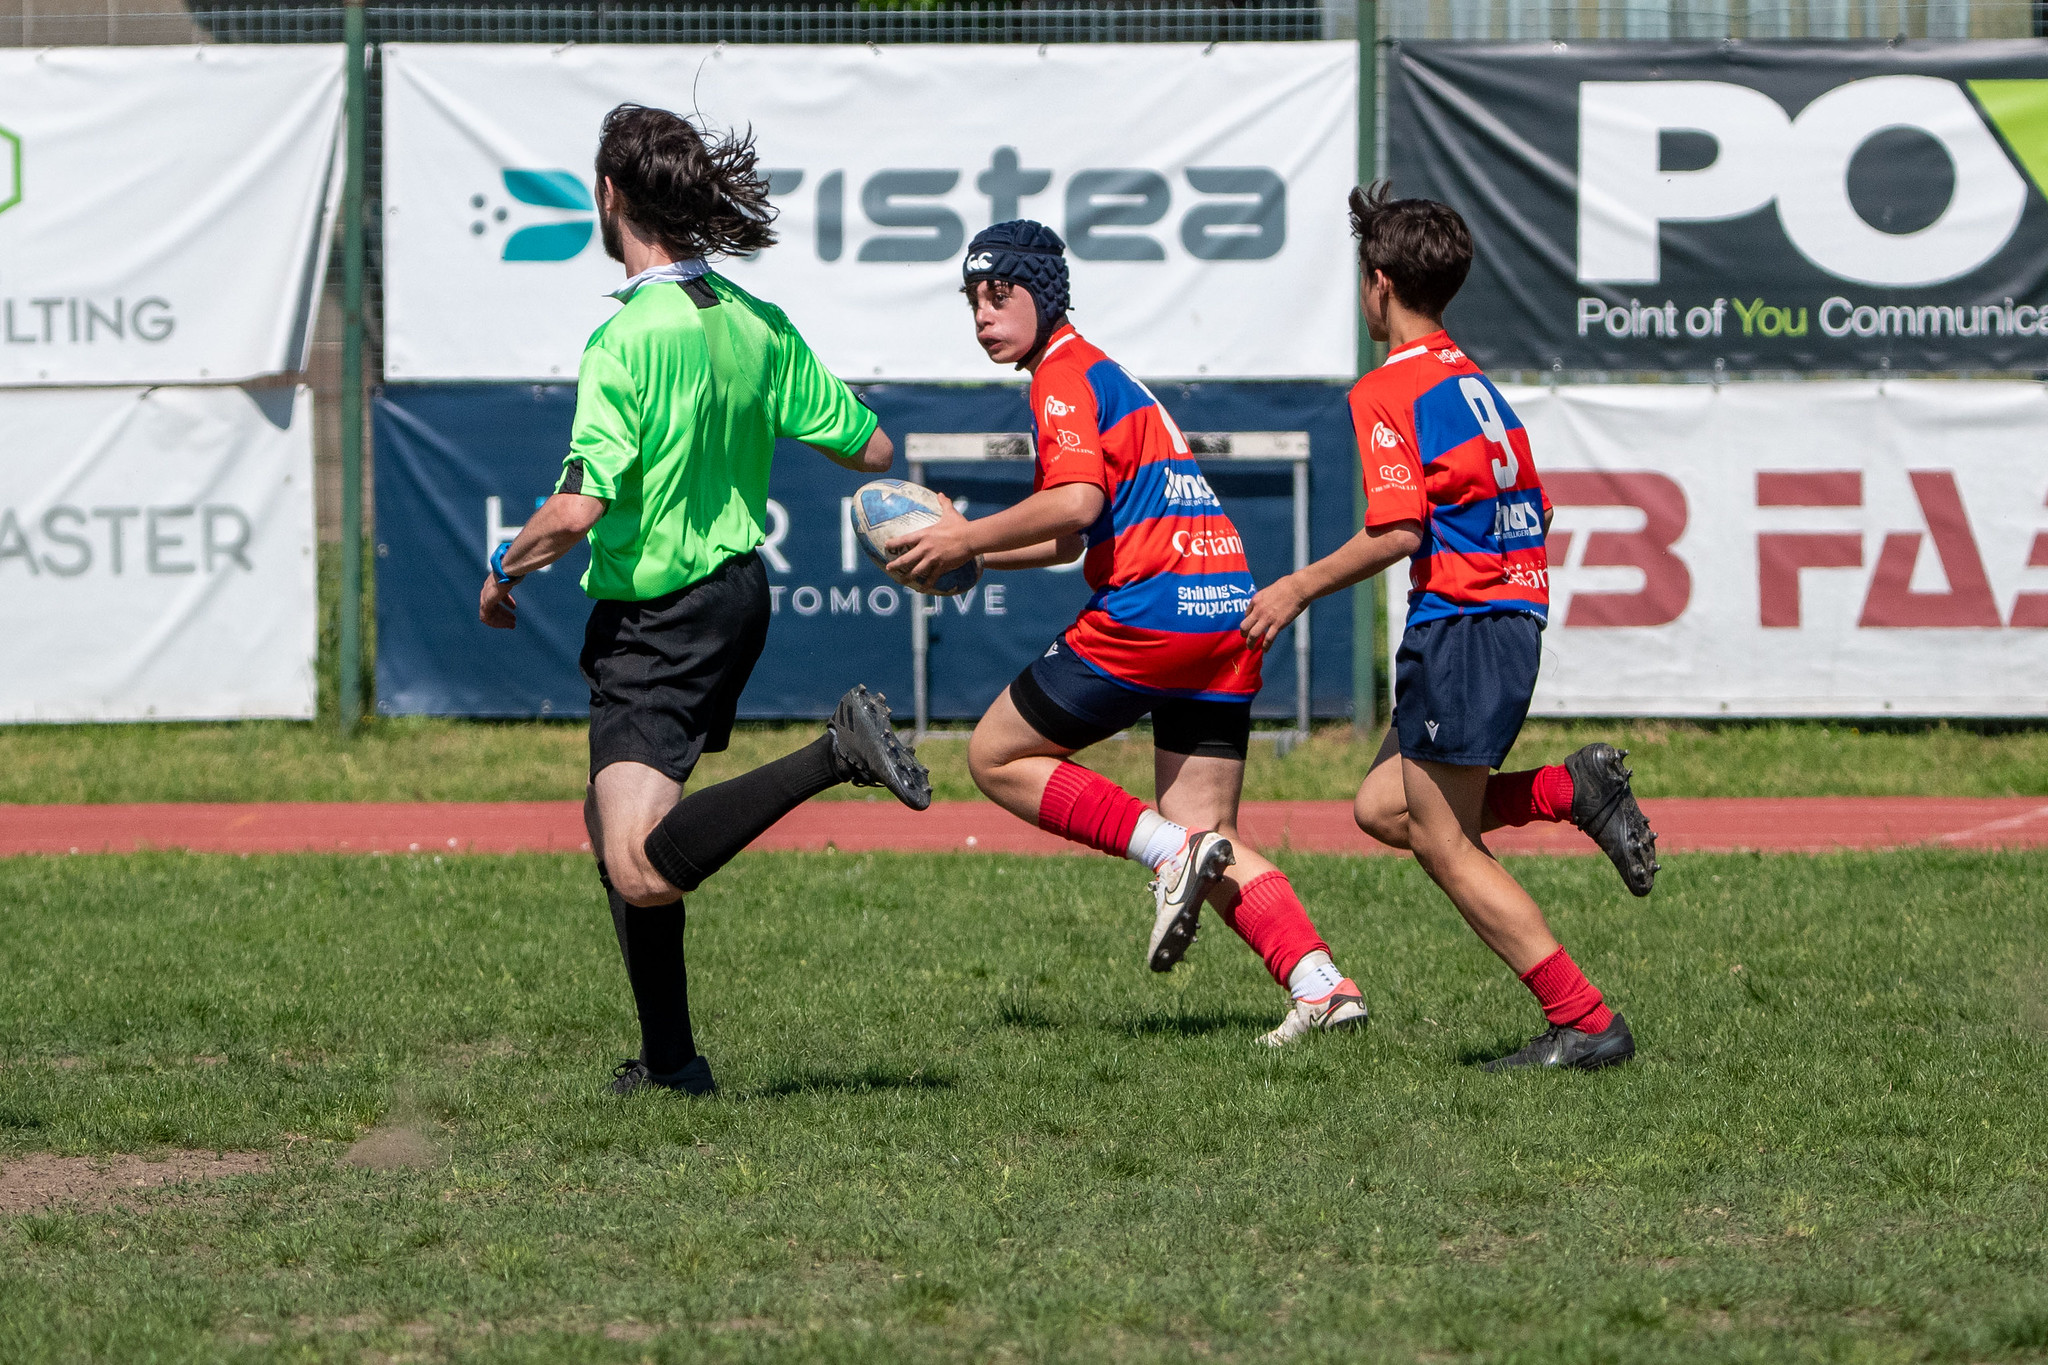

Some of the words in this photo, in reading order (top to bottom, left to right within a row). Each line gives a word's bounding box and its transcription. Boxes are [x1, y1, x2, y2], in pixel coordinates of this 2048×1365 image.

[5, 296, 175, 343] LTING
[1577, 298, 1678, 338] Point
[1685, 298, 1728, 338] of
[1732, 298, 1809, 338] You
[1458, 376, 1519, 489] 9
[0, 503, 253, 577] ASTER
[1755, 470, 2048, 628] FA
